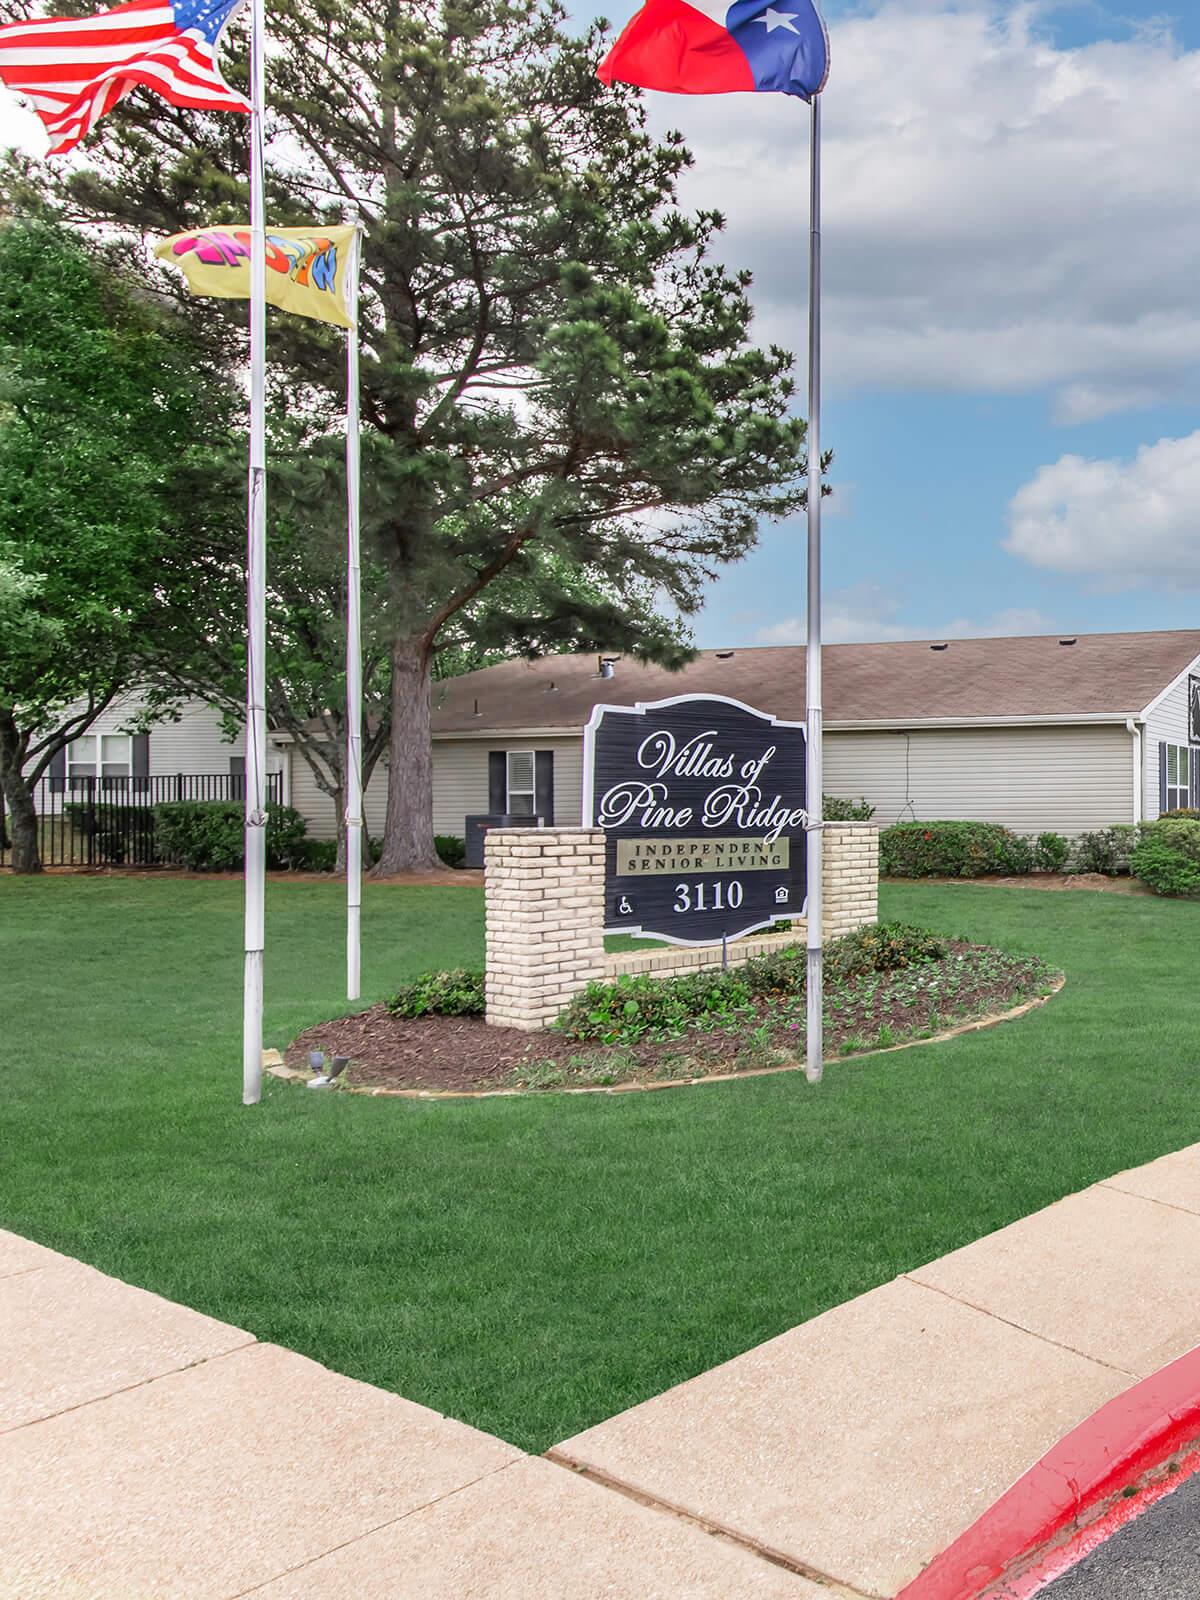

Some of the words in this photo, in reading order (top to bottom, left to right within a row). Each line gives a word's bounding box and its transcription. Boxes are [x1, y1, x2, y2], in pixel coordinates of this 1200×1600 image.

[637, 730, 735, 779] Villas
[740, 746, 776, 788] of
[597, 781, 693, 829] Pine
[702, 784, 806, 845] Ridge
[627, 857, 704, 871] SENIOR
[716, 854, 782, 868] LIVING
[634, 842, 777, 857] INDEPENDENT
[673, 880, 743, 914] 3110
